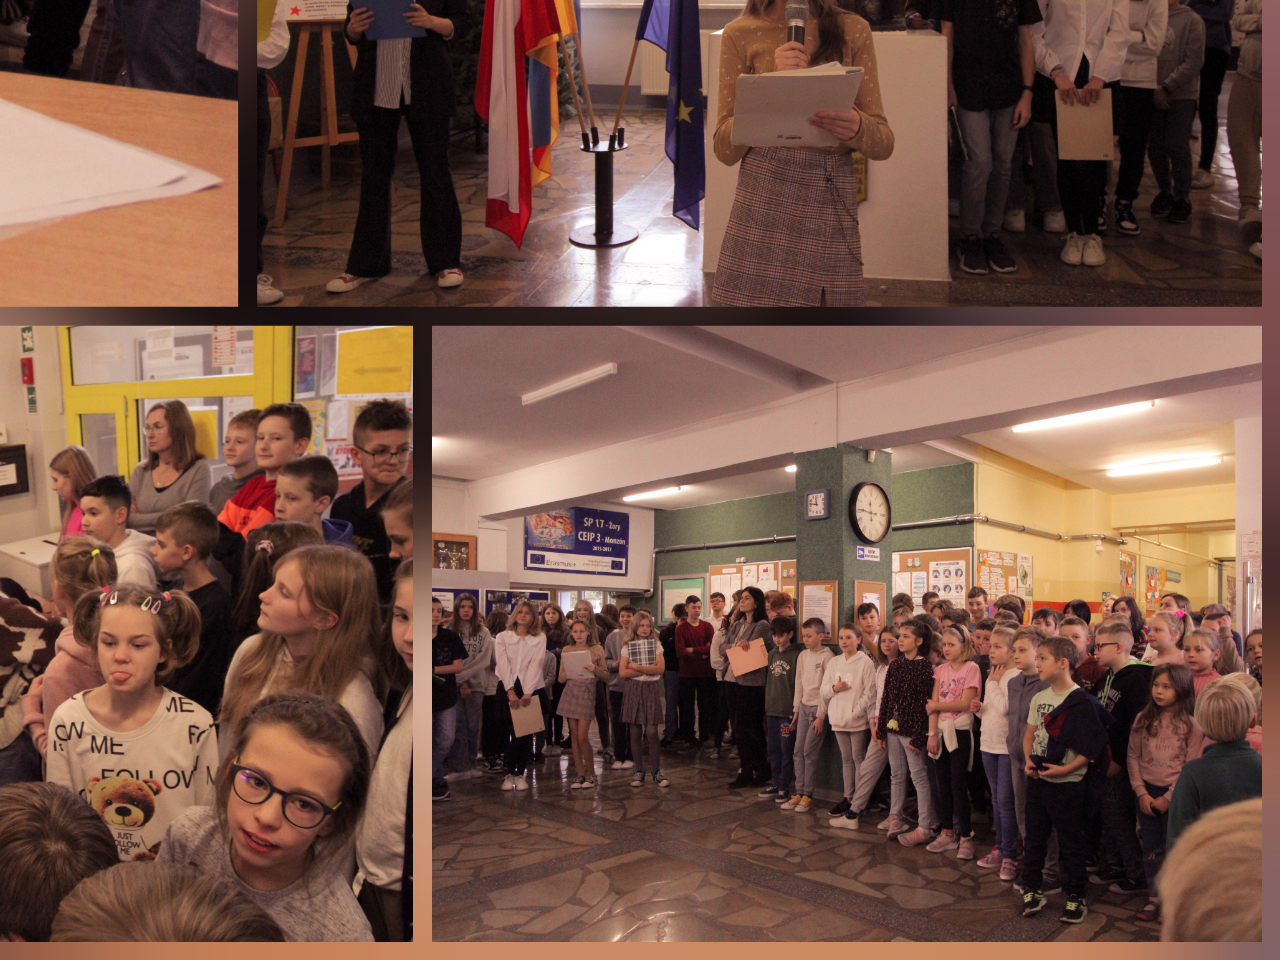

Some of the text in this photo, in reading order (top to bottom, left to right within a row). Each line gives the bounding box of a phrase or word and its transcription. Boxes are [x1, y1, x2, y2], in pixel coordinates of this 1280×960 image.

[583, 517, 594, 527] SP
[595, 519, 604, 529] 17
[609, 520, 621, 532] Żory
[577, 531, 595, 543] CEIP
[596, 533, 601, 543] 3
[546, 559, 577, 568] Erasmus+
[91, 735, 125, 756] ME
[117, 832, 133, 840] JUST
[114, 839, 141, 849] OLLOW
[120, 848, 130, 856] ME
